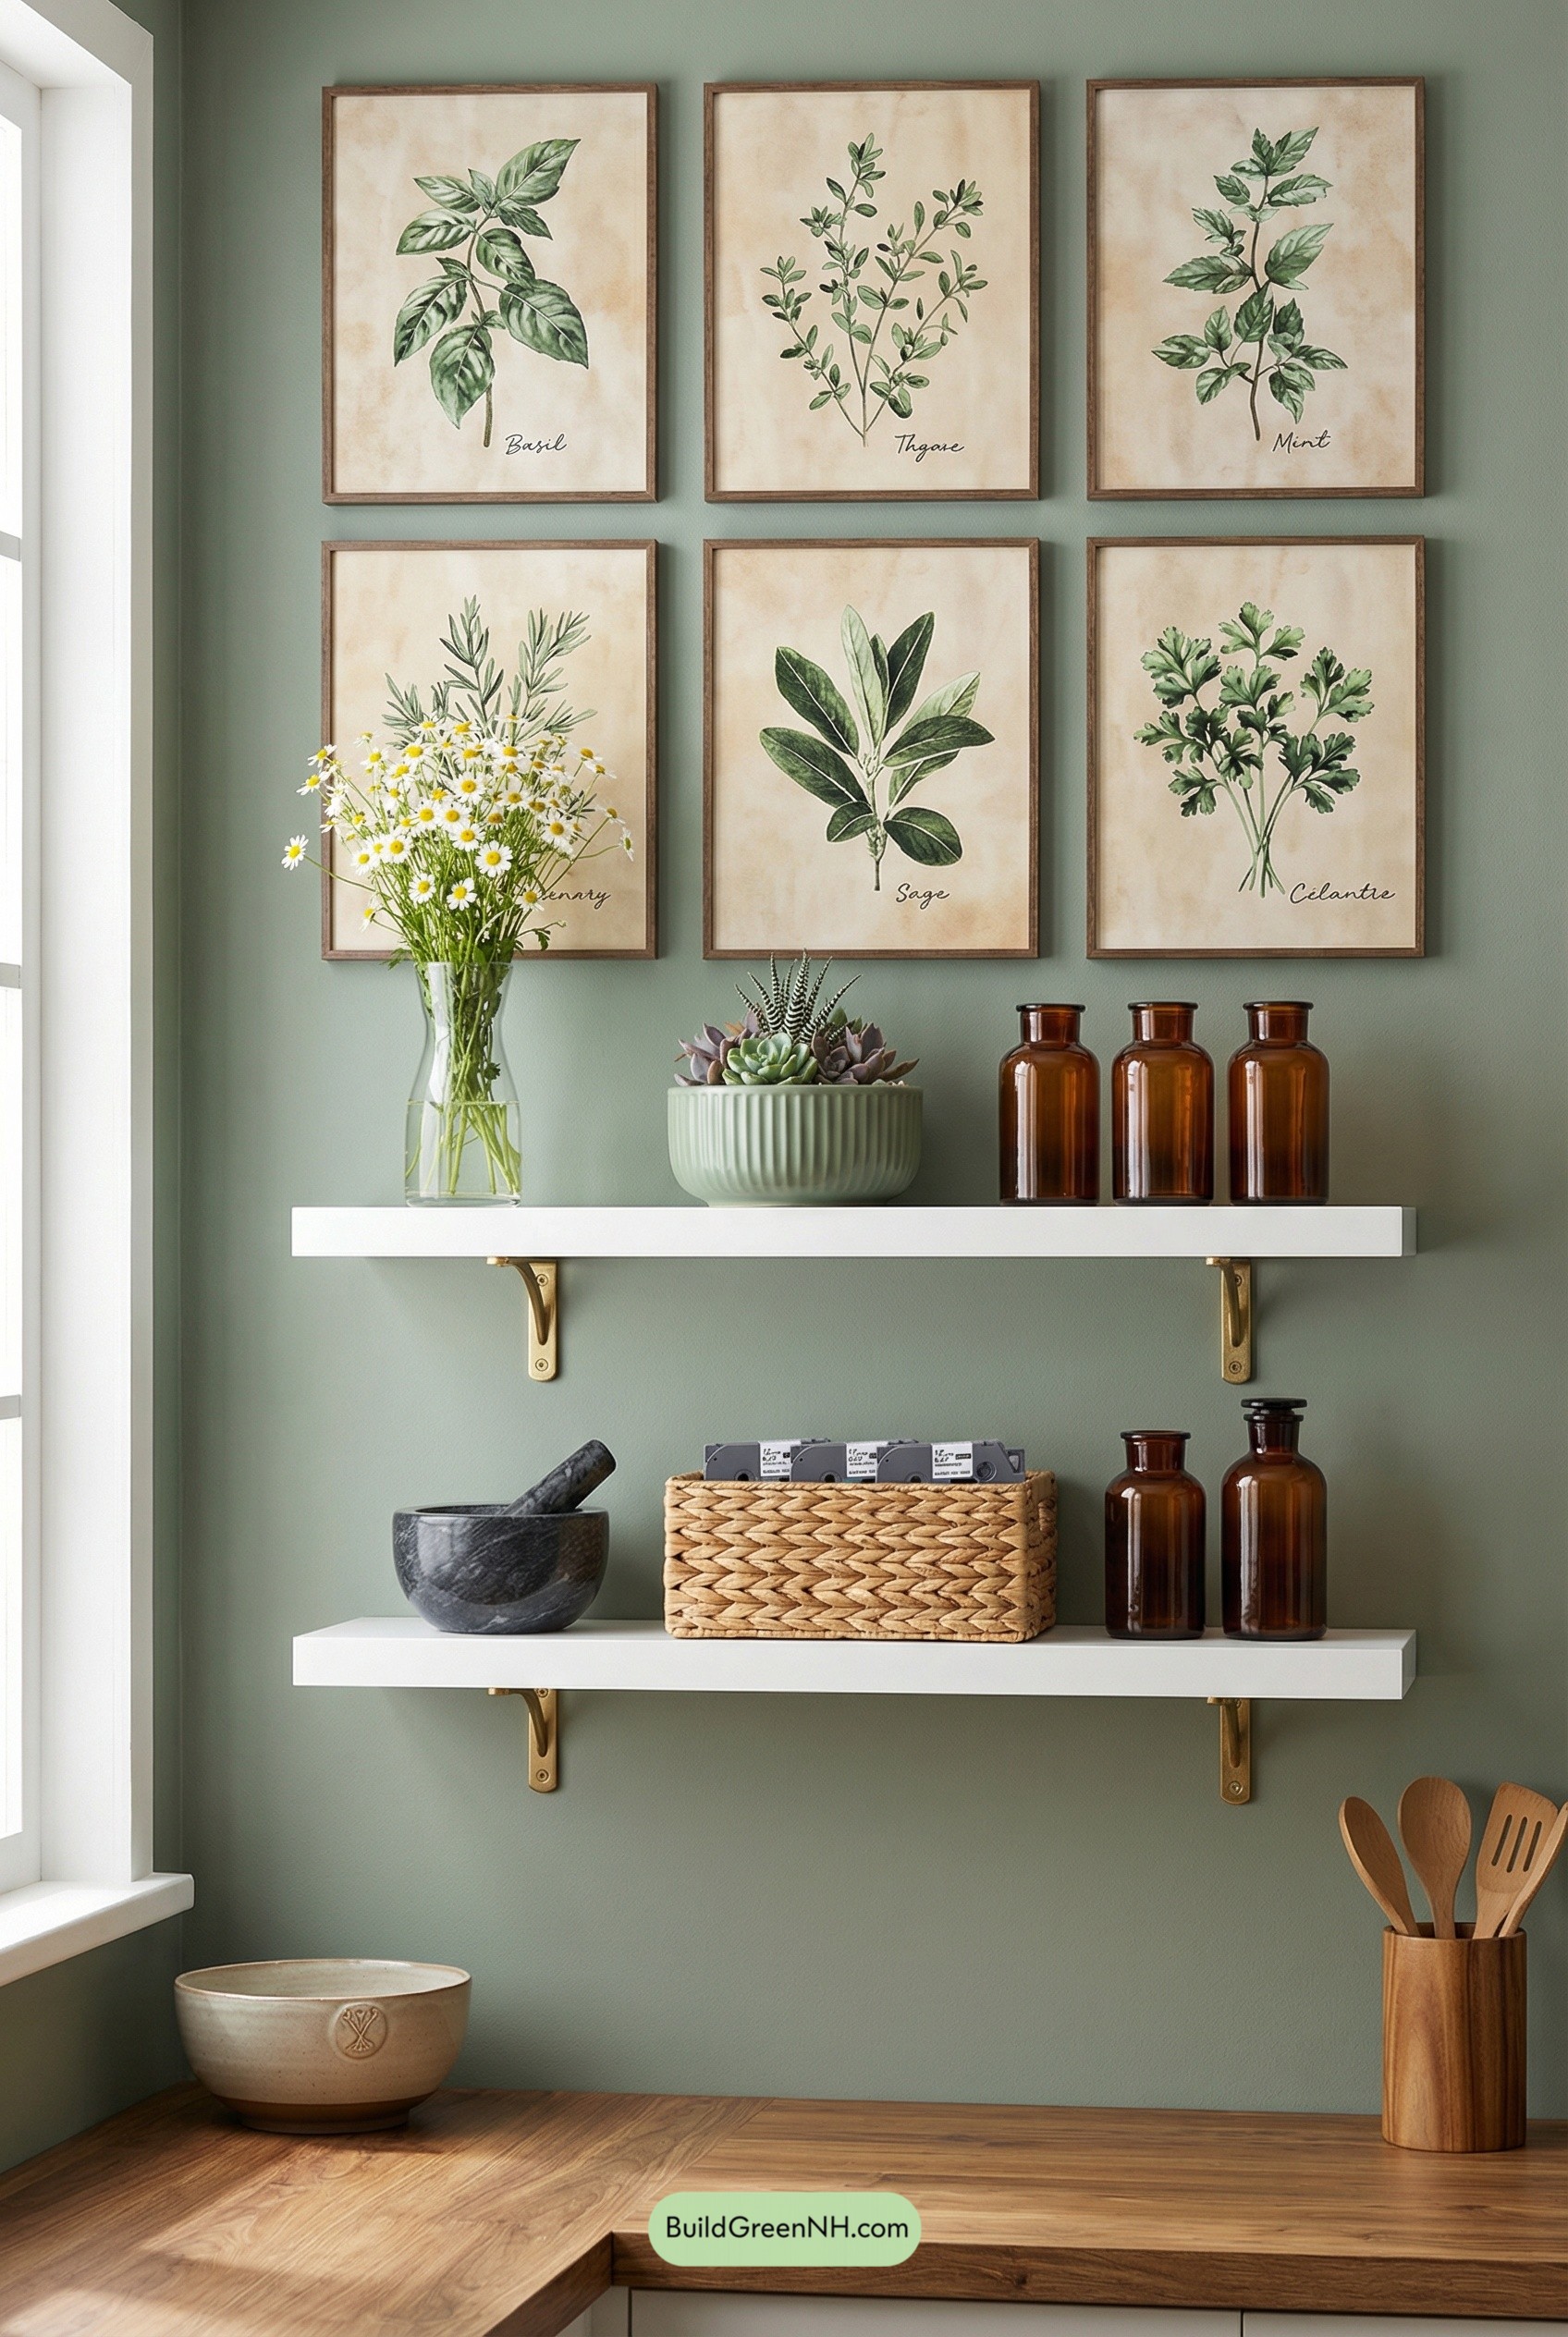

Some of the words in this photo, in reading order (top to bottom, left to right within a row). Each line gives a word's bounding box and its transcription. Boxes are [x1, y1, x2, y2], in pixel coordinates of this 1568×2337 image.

[505, 433, 568, 455] Basil
[1272, 429, 1331, 454] Mint
[895, 882, 950, 910] Sage
